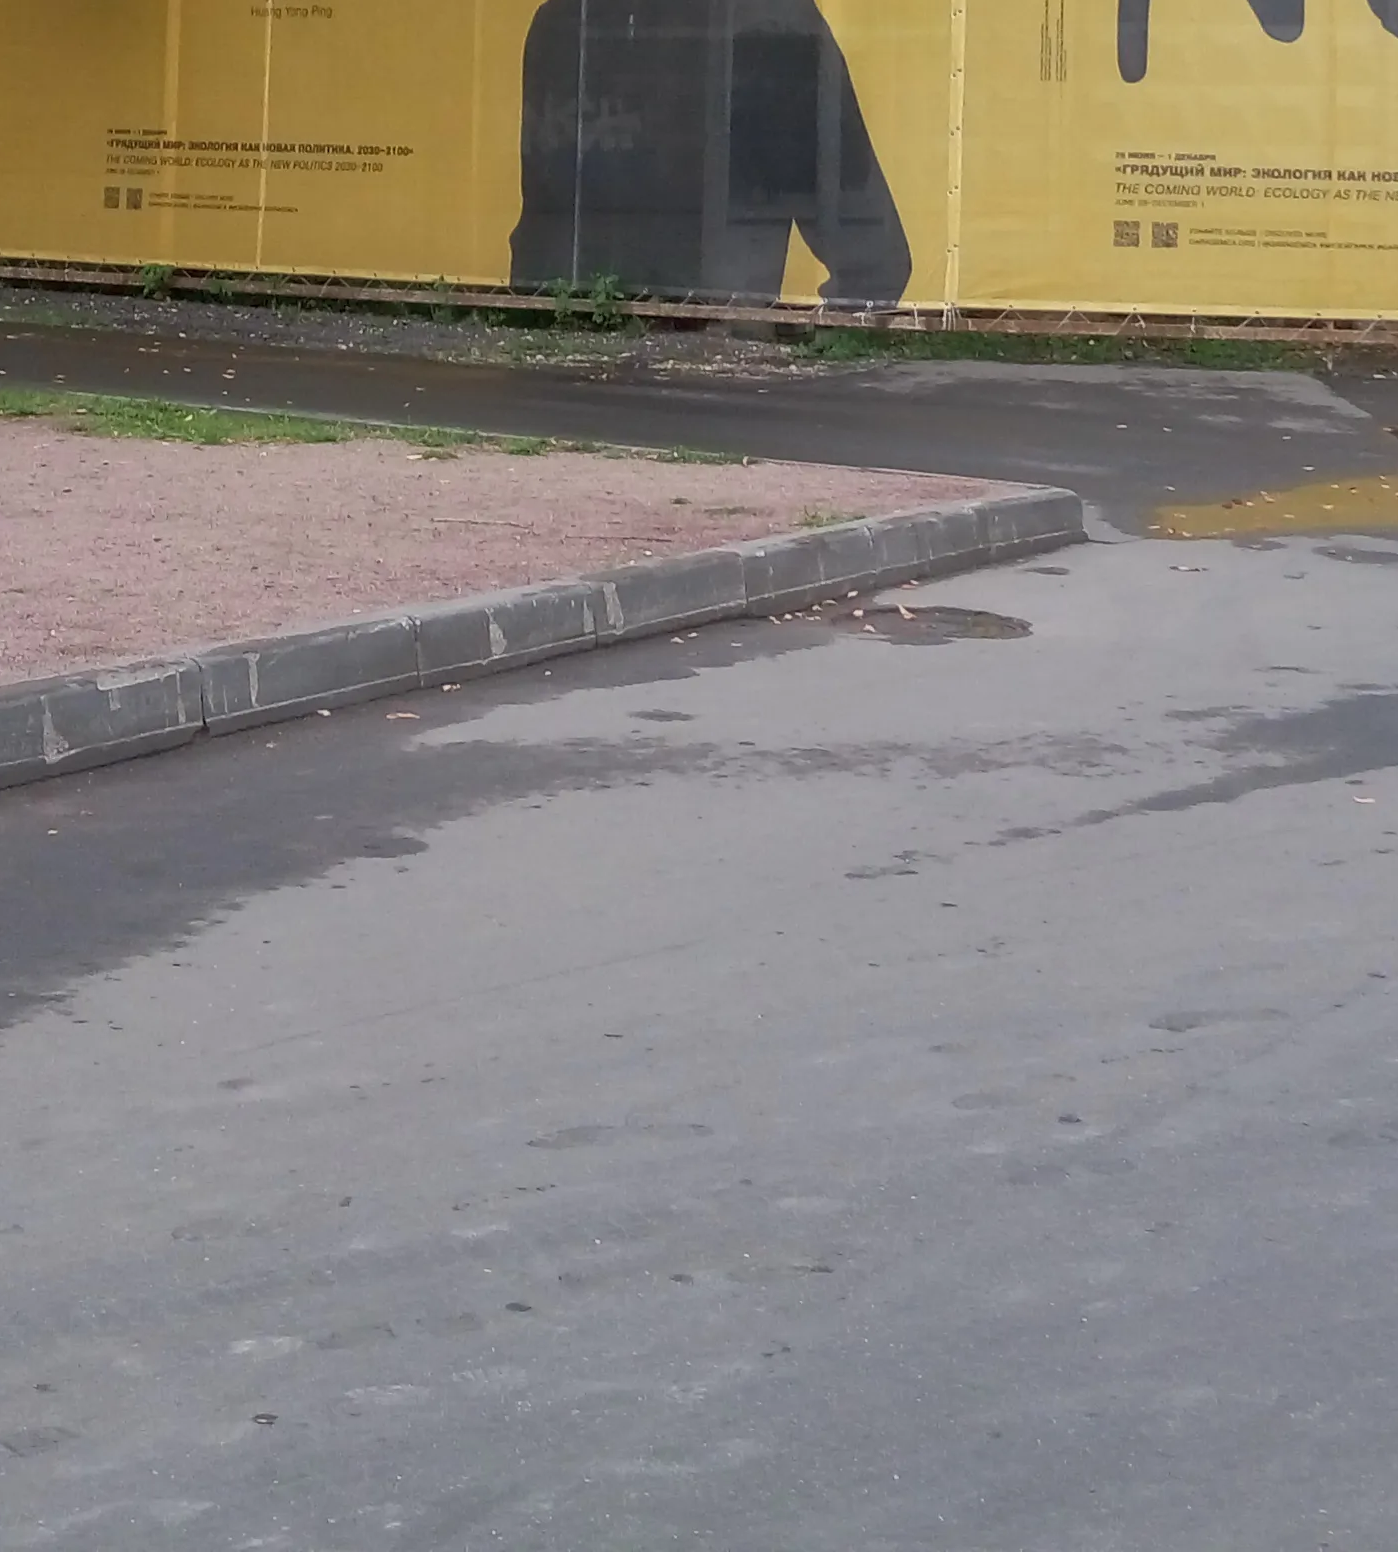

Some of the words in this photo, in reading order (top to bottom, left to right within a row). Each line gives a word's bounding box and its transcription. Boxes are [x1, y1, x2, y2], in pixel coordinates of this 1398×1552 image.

[1115, 163, 1205, 179] «ГРЯДУЩИЙ
[1209, 166, 1247, 179] МИР:
[1251, 167, 1333, 181] ЭКОЛОГИЯ
[1337, 169, 1367, 182] КАК
[1115, 182, 1140, 195] THE
[1144, 183, 1201, 196] COMING
[1264, 187, 1329, 200] ECOLOGY
[1333, 189, 1351, 201] AS
[1355, 189, 1381, 202] THE
